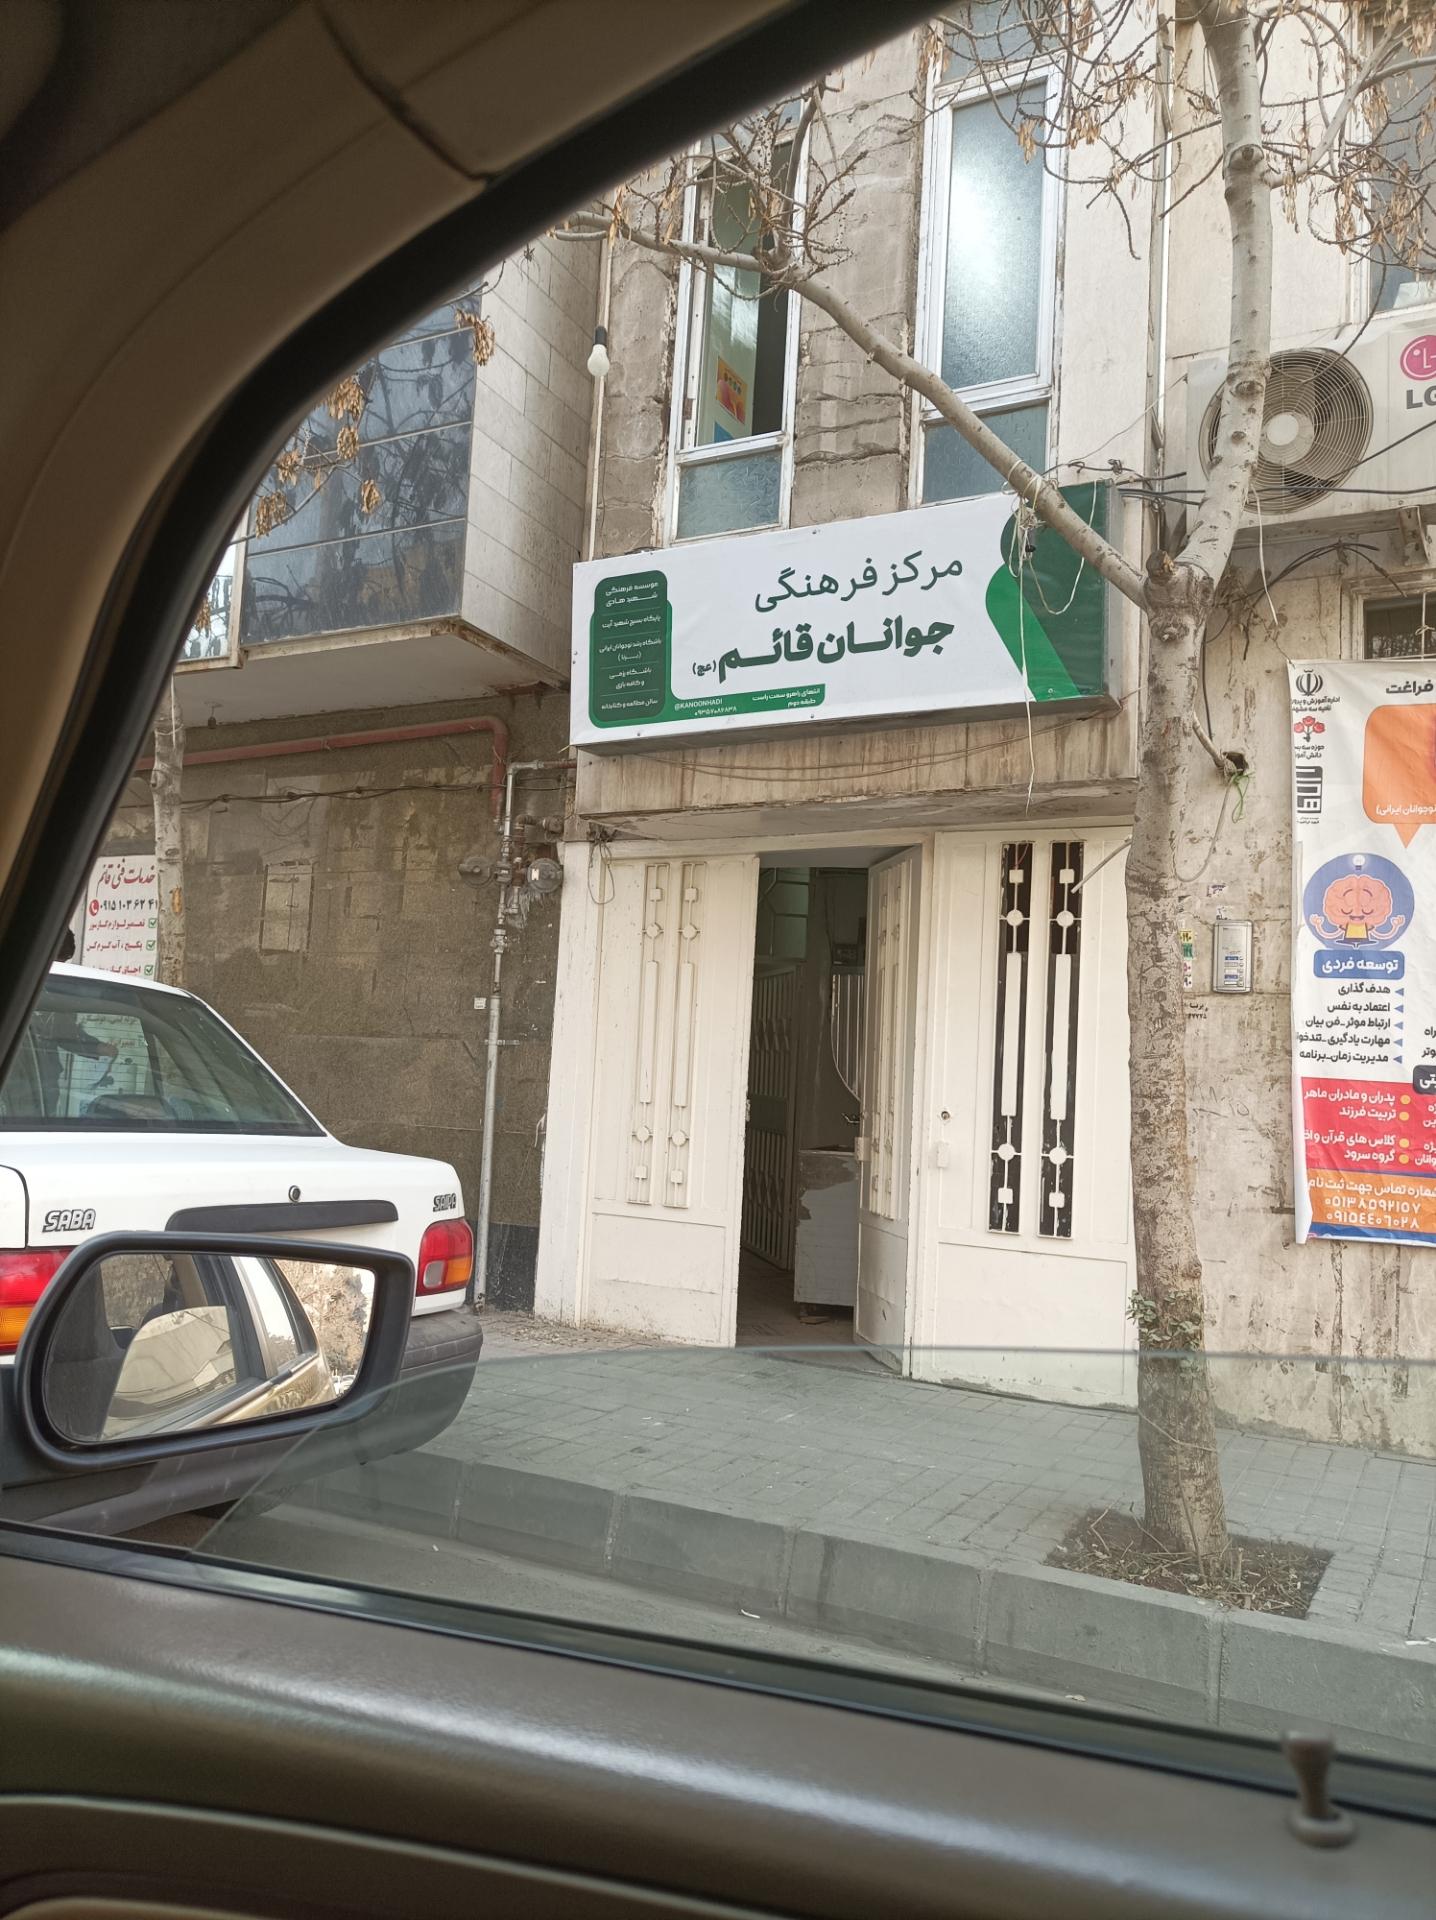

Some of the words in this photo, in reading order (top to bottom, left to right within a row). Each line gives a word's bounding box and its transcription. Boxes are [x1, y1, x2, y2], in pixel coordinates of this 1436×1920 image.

[883, 550, 963, 596] مرکز
[605, 585, 633, 596] فرهنگی
[634, 581, 658, 590] موسسه
[755, 557, 878, 613] فرهنگی
[605, 597, 626, 608] هادی
[817, 615, 955, 664] جوانان
[718, 622, 814, 684] قائم
[1385, 678, 1435, 697] فراغت
[752, 693, 769, 702] راست
[800, 697, 816, 705] طبقه
[96, 863, 114, 897] قائم
[111, 857, 125, 890] فنی
[123, 864, 156, 884] خدمات
[1321, 956, 1355, 973] فردی
[1356, 958, 1399, 974] توسعه
[1337, 983, 1364, 996] گذاری
[1365, 985, 1391, 995] هدف
[1327, 1003, 1352, 1013] نفس
[1352, 1003, 1363, 1014] به
[1363, 1002, 1391, 1013] اعتماد
[1305, 1016, 1324, 1028] بیان
[1367, 1018, 1391, 1030] ارتباط
[1327, 1033, 1361, 1046] یادگیری
[1361, 1035, 1391, 1048] مهارت
[1353, 1052, 1389, 1063] مدیریت
[1304, 1087, 1328, 1099] ماهر
[1328, 1089, 1360, 1102] مادران
[1360, 1092, 1367, 1103] و
[1368, 1091, 1396, 1106] پدران
[1339, 1105, 1366, 1118] فرزند
[1367, 1108, 1397, 1121] تربیت
[1314, 1132, 1320, 1144] و
[1321, 1129, 1346, 1145] قرآن
[1346, 1132, 1367, 1148] های
[1368, 1133, 1396, 1147] کلاس
[1344, 1149, 1371, 1161] سرود
[1372, 1149, 1395, 1163] گروه
[1324, 1177, 1345, 1193] ثبت
[1345, 1180, 1373, 1195] جهت
[1374, 1183, 1406, 1196] تماس
[433, 1192, 458, 1213] SAIPA
[41, 1207, 97, 1233] SABA
